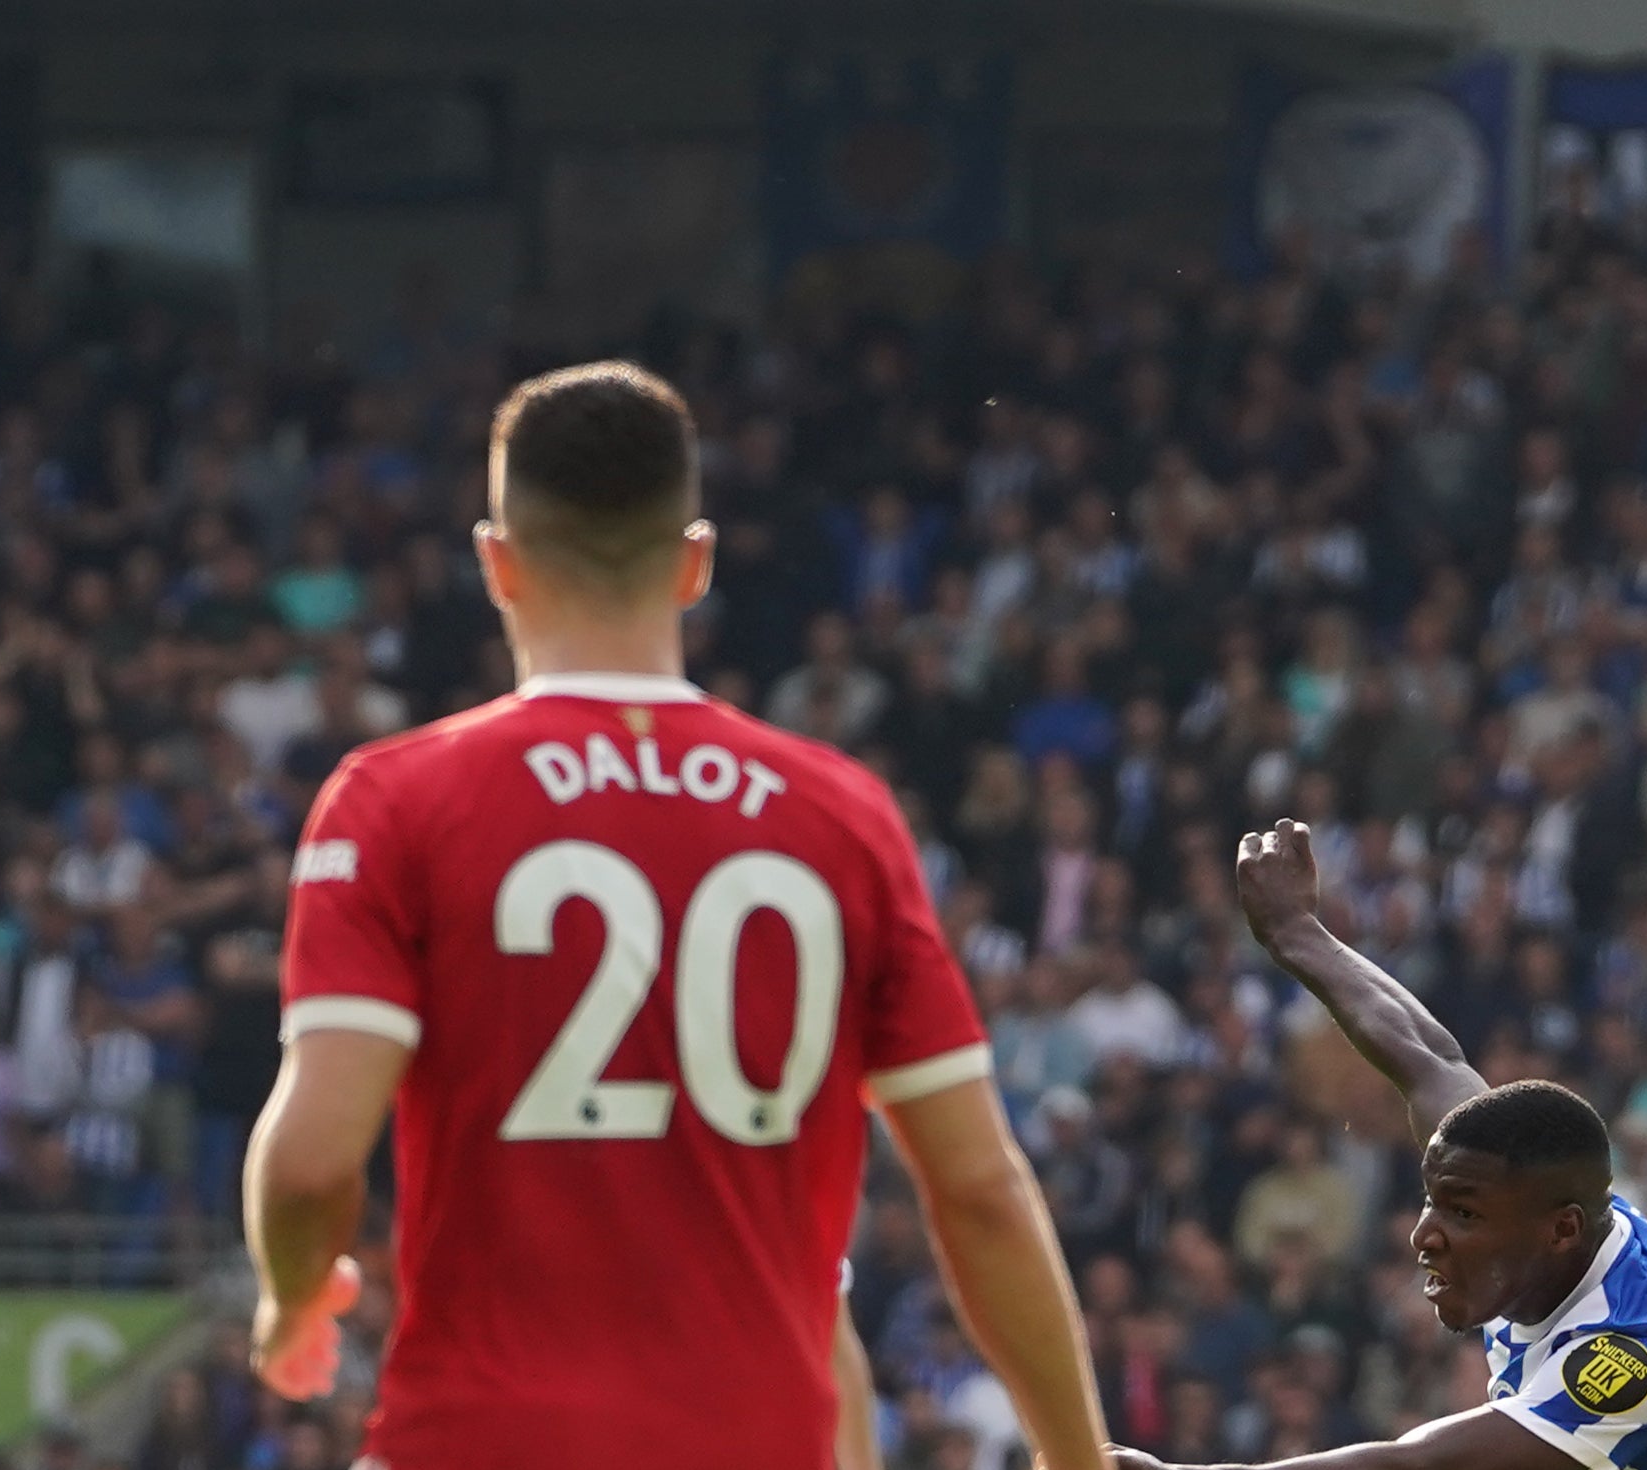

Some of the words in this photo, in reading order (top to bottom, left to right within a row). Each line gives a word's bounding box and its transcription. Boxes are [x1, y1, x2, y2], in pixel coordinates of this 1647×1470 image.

[523, 733, 787, 819] DALOT
[493, 838, 846, 1147] 20
[1585, 1358, 1626, 1393] UK
